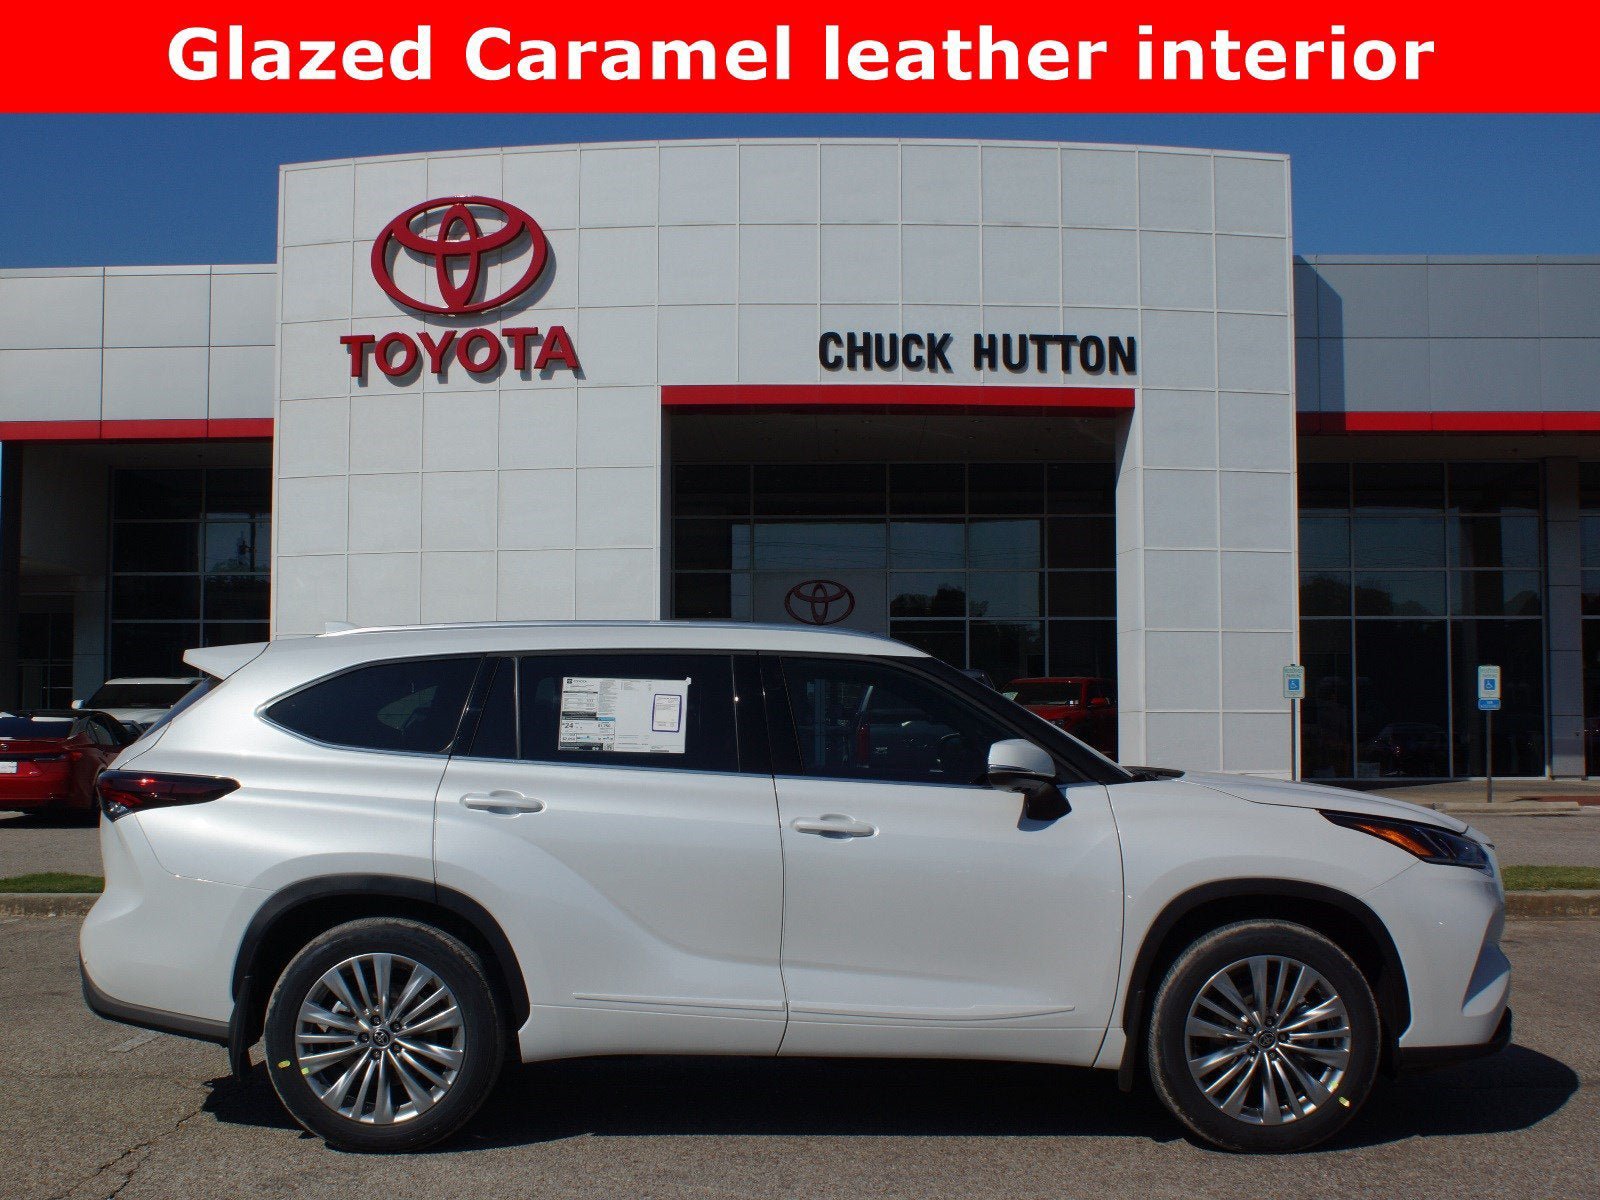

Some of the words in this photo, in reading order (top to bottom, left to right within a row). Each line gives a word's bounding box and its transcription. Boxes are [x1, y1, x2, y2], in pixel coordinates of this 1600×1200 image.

[340, 325, 579, 378] TOYOTA
[818, 331, 953, 373] CHUCK
[972, 333, 1137, 375] HUTTON
